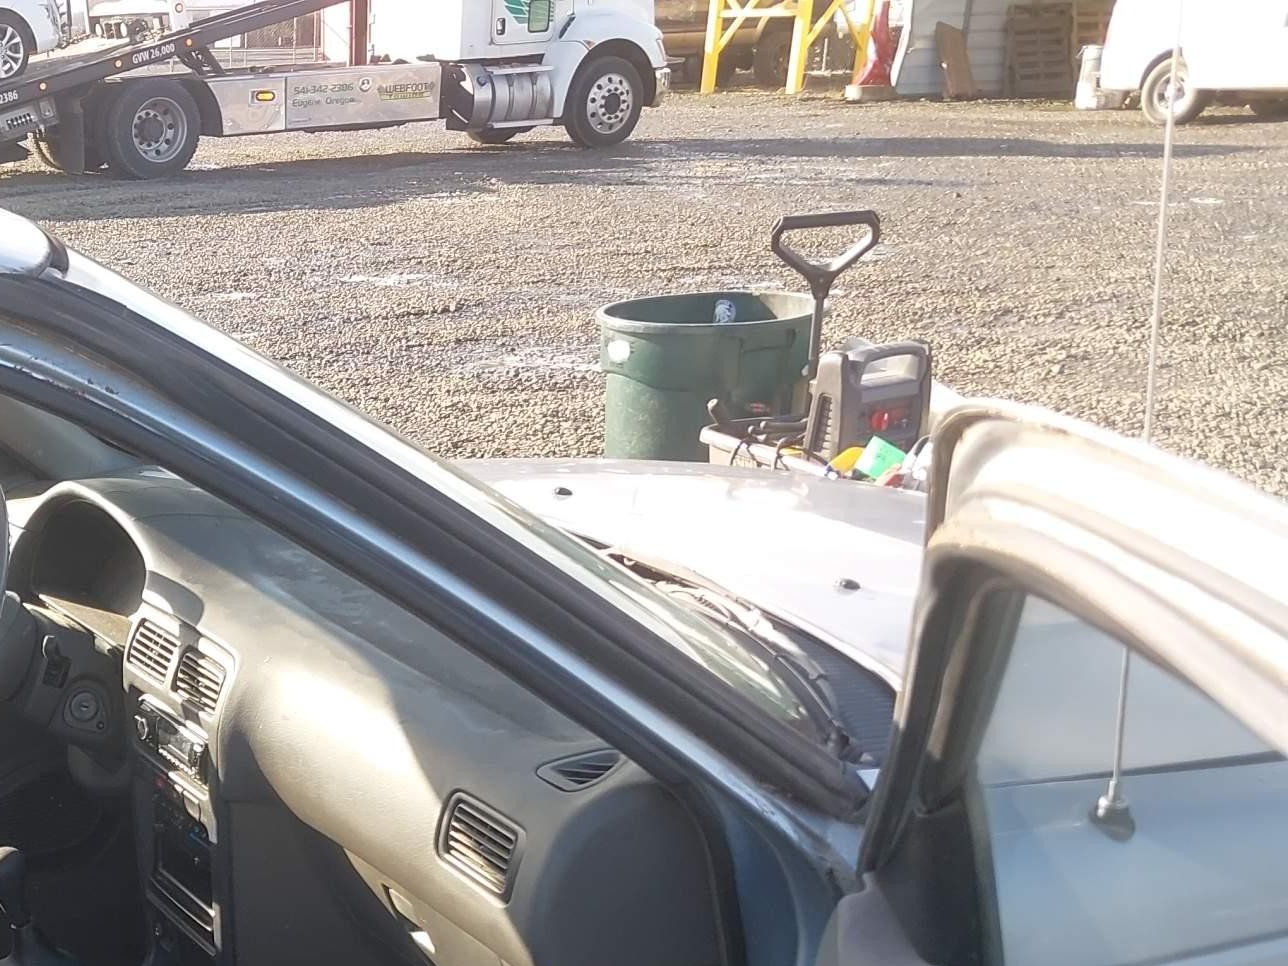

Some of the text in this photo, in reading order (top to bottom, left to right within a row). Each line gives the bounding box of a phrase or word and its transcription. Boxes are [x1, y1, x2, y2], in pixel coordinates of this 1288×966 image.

[132, 43, 176, 64] GVW 26,000
[385, 82, 428, 93] WEBFOOT
